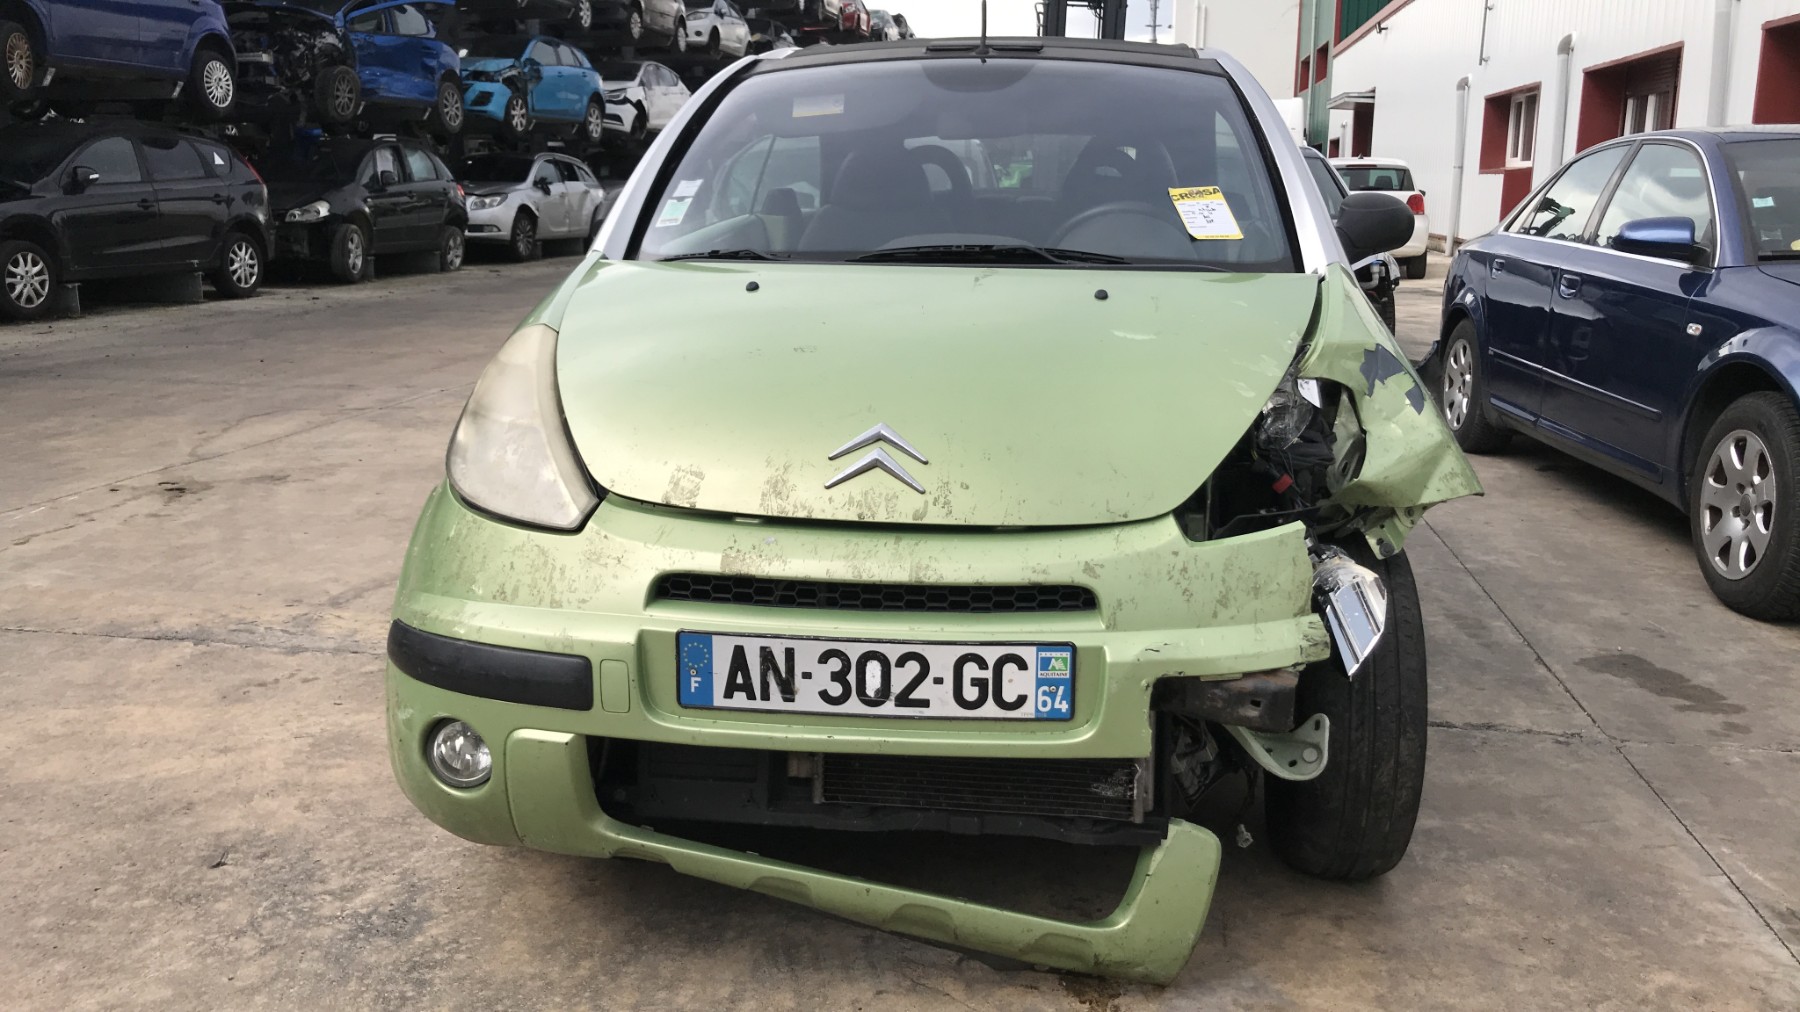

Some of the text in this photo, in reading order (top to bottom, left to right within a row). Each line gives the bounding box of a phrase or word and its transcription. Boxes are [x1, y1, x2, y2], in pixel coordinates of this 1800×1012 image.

[690, 677, 701, 692] F
[723, 644, 1029, 711] AN-302-GC
[1037, 685, 1068, 712] 64
